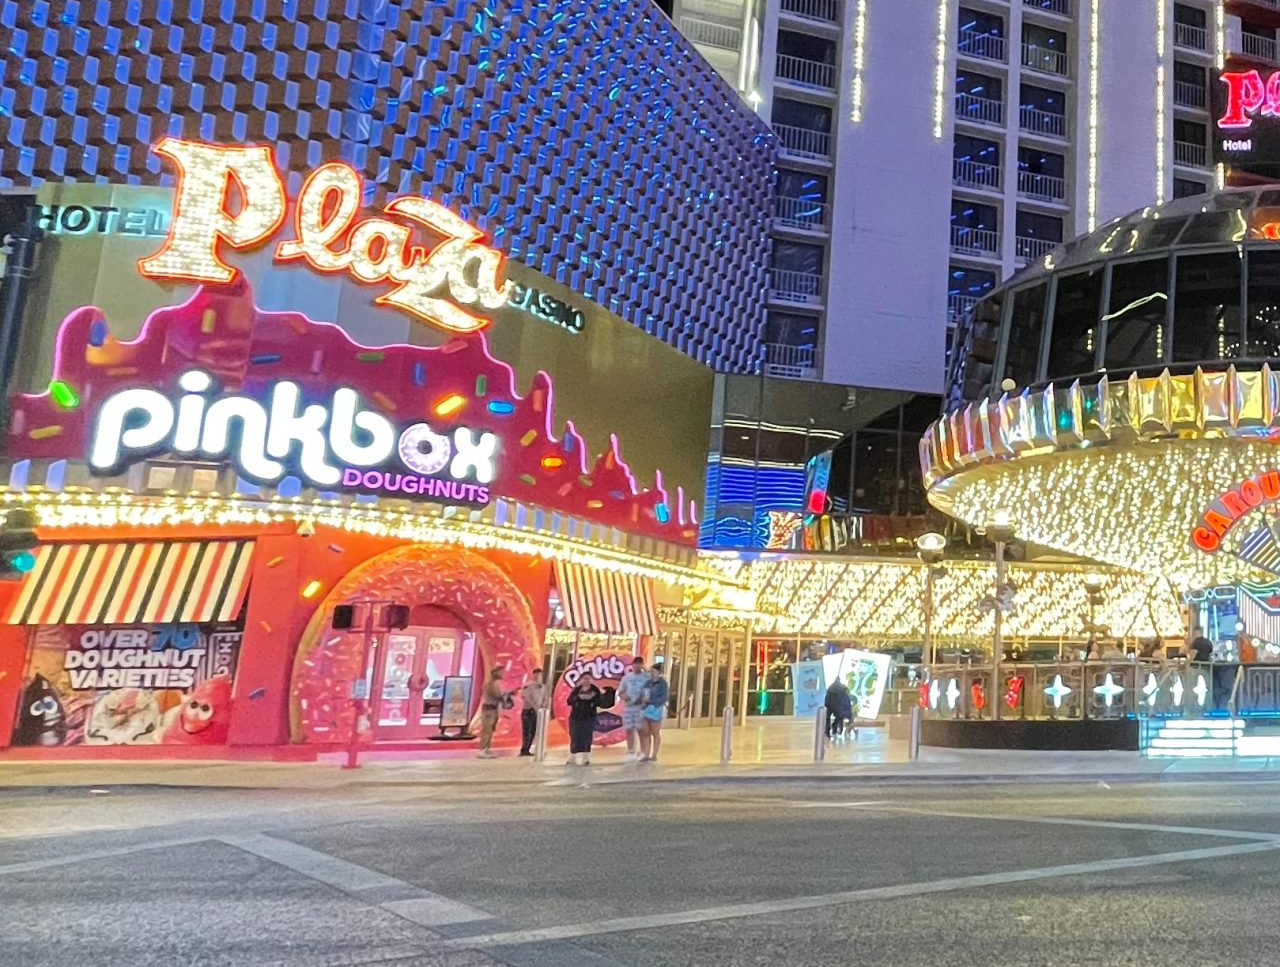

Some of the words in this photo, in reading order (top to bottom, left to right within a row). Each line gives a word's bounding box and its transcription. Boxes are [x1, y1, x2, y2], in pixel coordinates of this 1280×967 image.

[1222, 139, 1252, 151] Hotel
[36, 204, 170, 237] HOTEL
[138, 136, 514, 333] Plaza
[89, 370, 499, 485] pinkbox
[342, 467, 491, 504] DOUGHNUTS
[80, 629, 149, 649] OVER
[151, 623, 201, 651] 70
[64, 648, 206, 669] DOUGHNUT
[564, 655, 637, 688] pinkbo
[68, 668, 195, 689] VARIETIES
